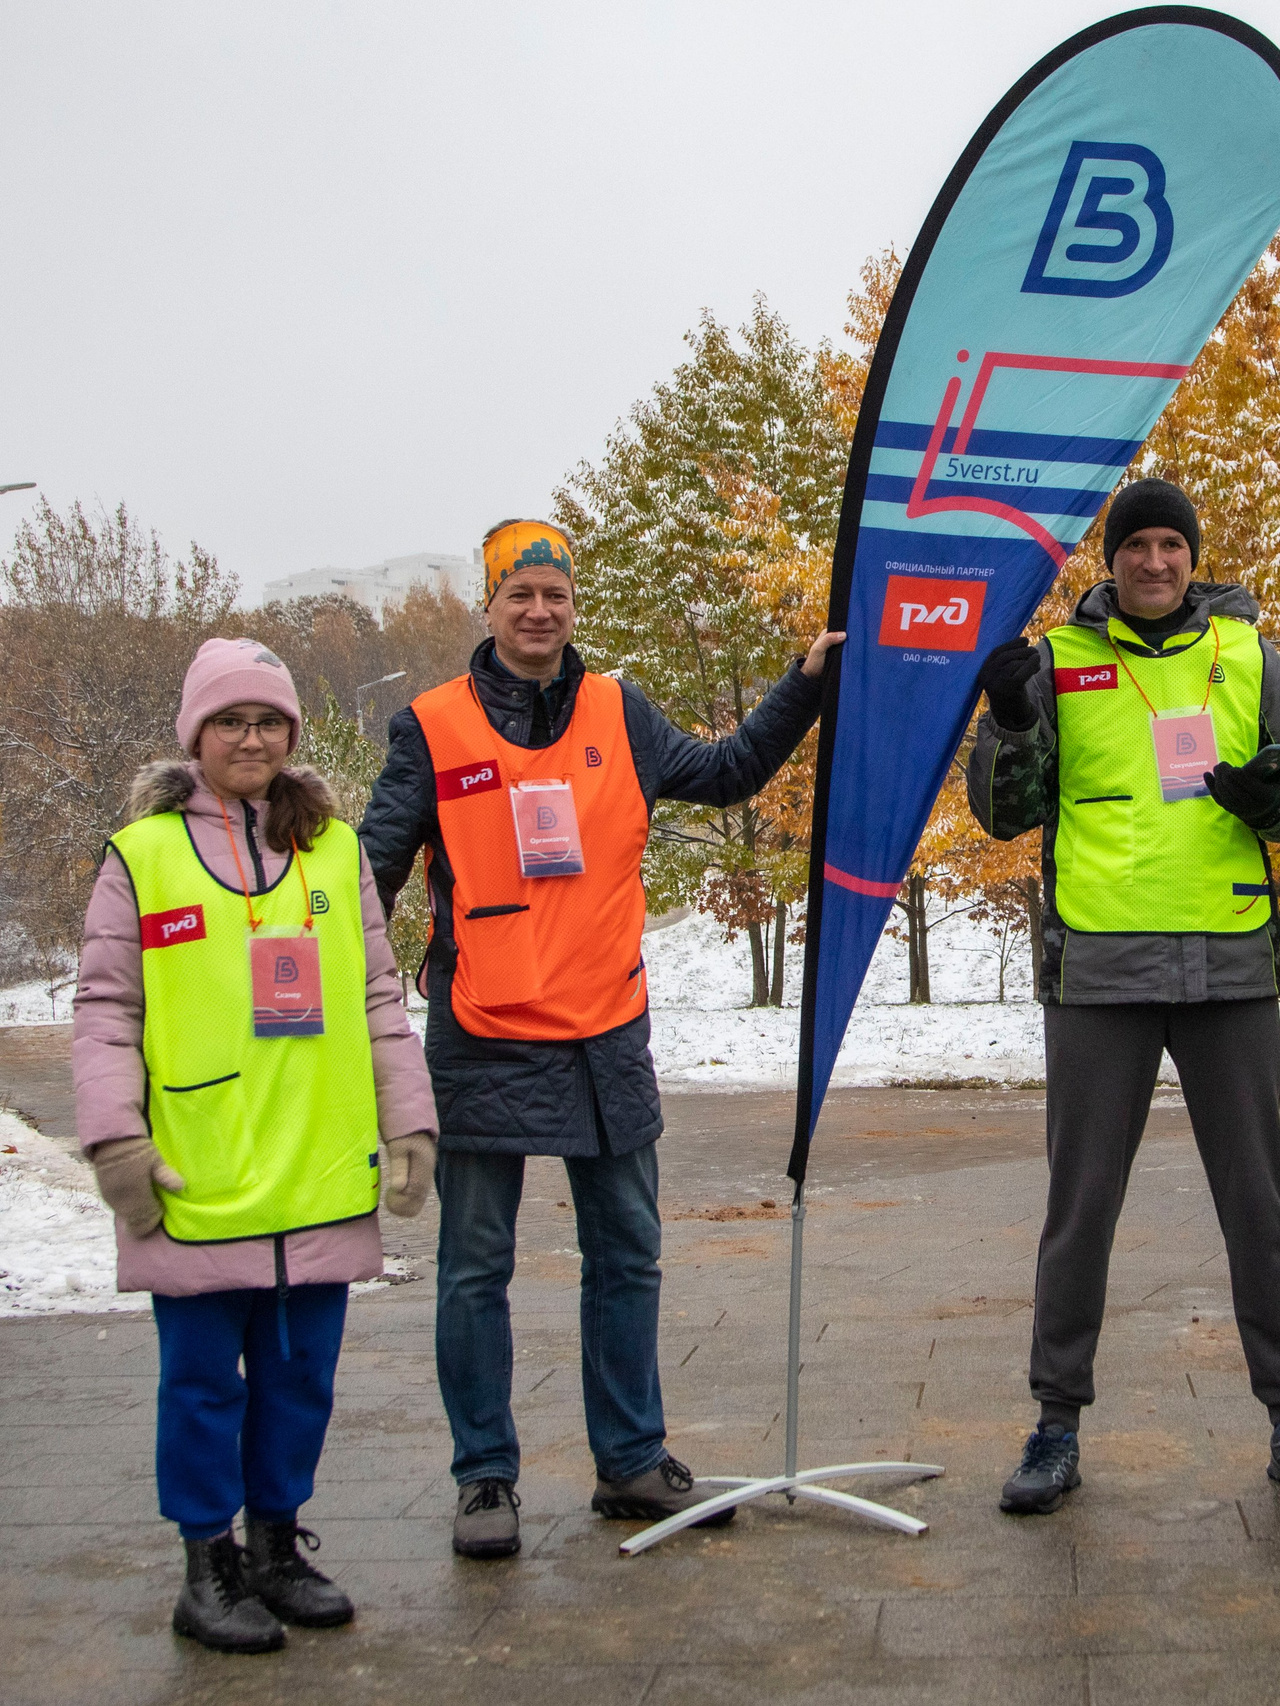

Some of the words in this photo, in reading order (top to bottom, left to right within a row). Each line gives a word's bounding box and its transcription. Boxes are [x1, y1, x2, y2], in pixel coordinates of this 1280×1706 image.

[945, 457, 1040, 484] 5verst.ru
[885, 560, 955, 575] ОФИЦИАЛЬНЫЙ
[956, 566, 995, 577] ПАРТНЕР
[902, 653, 921, 663] ОАО
[922, 655, 951, 665] «РЖД»
